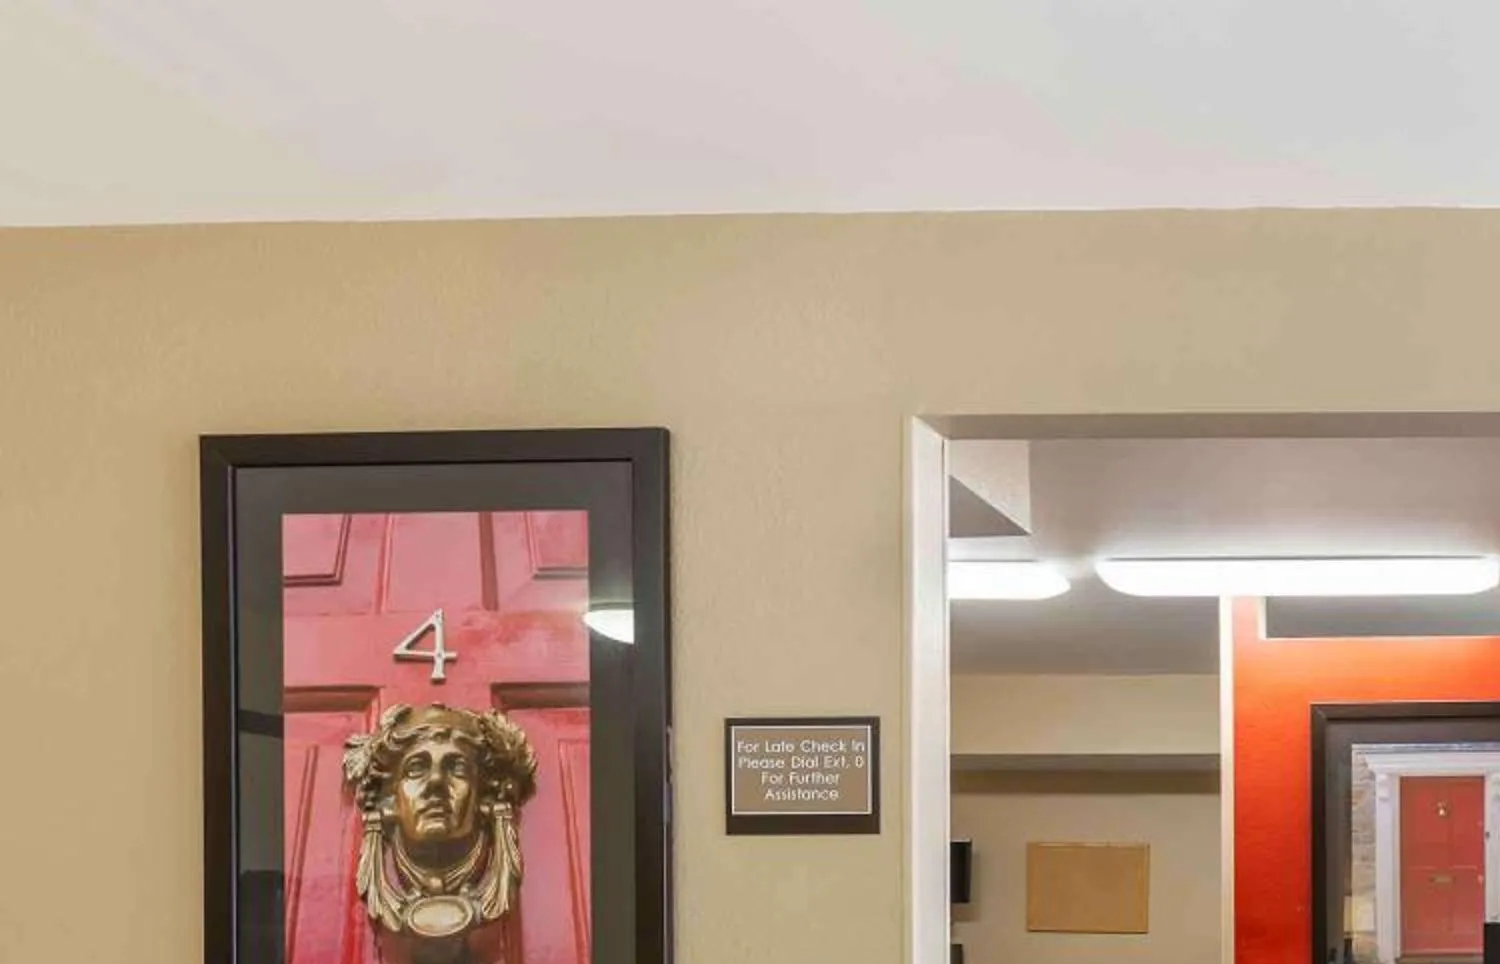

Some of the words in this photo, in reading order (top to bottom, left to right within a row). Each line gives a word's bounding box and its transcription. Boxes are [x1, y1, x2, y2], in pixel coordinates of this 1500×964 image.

[393, 608, 457, 682] 4
[736, 740, 760, 753] For
[765, 740, 795, 753] Late
[800, 739, 847, 753] Check
[852, 740, 865, 753] In
[738, 756, 785, 769] Please
[791, 755, 819, 769] Dial
[855, 756, 865, 769] 0
[761, 771, 784, 785] For
[789, 771, 840, 785] Further
[764, 787, 840, 801] Assistance
